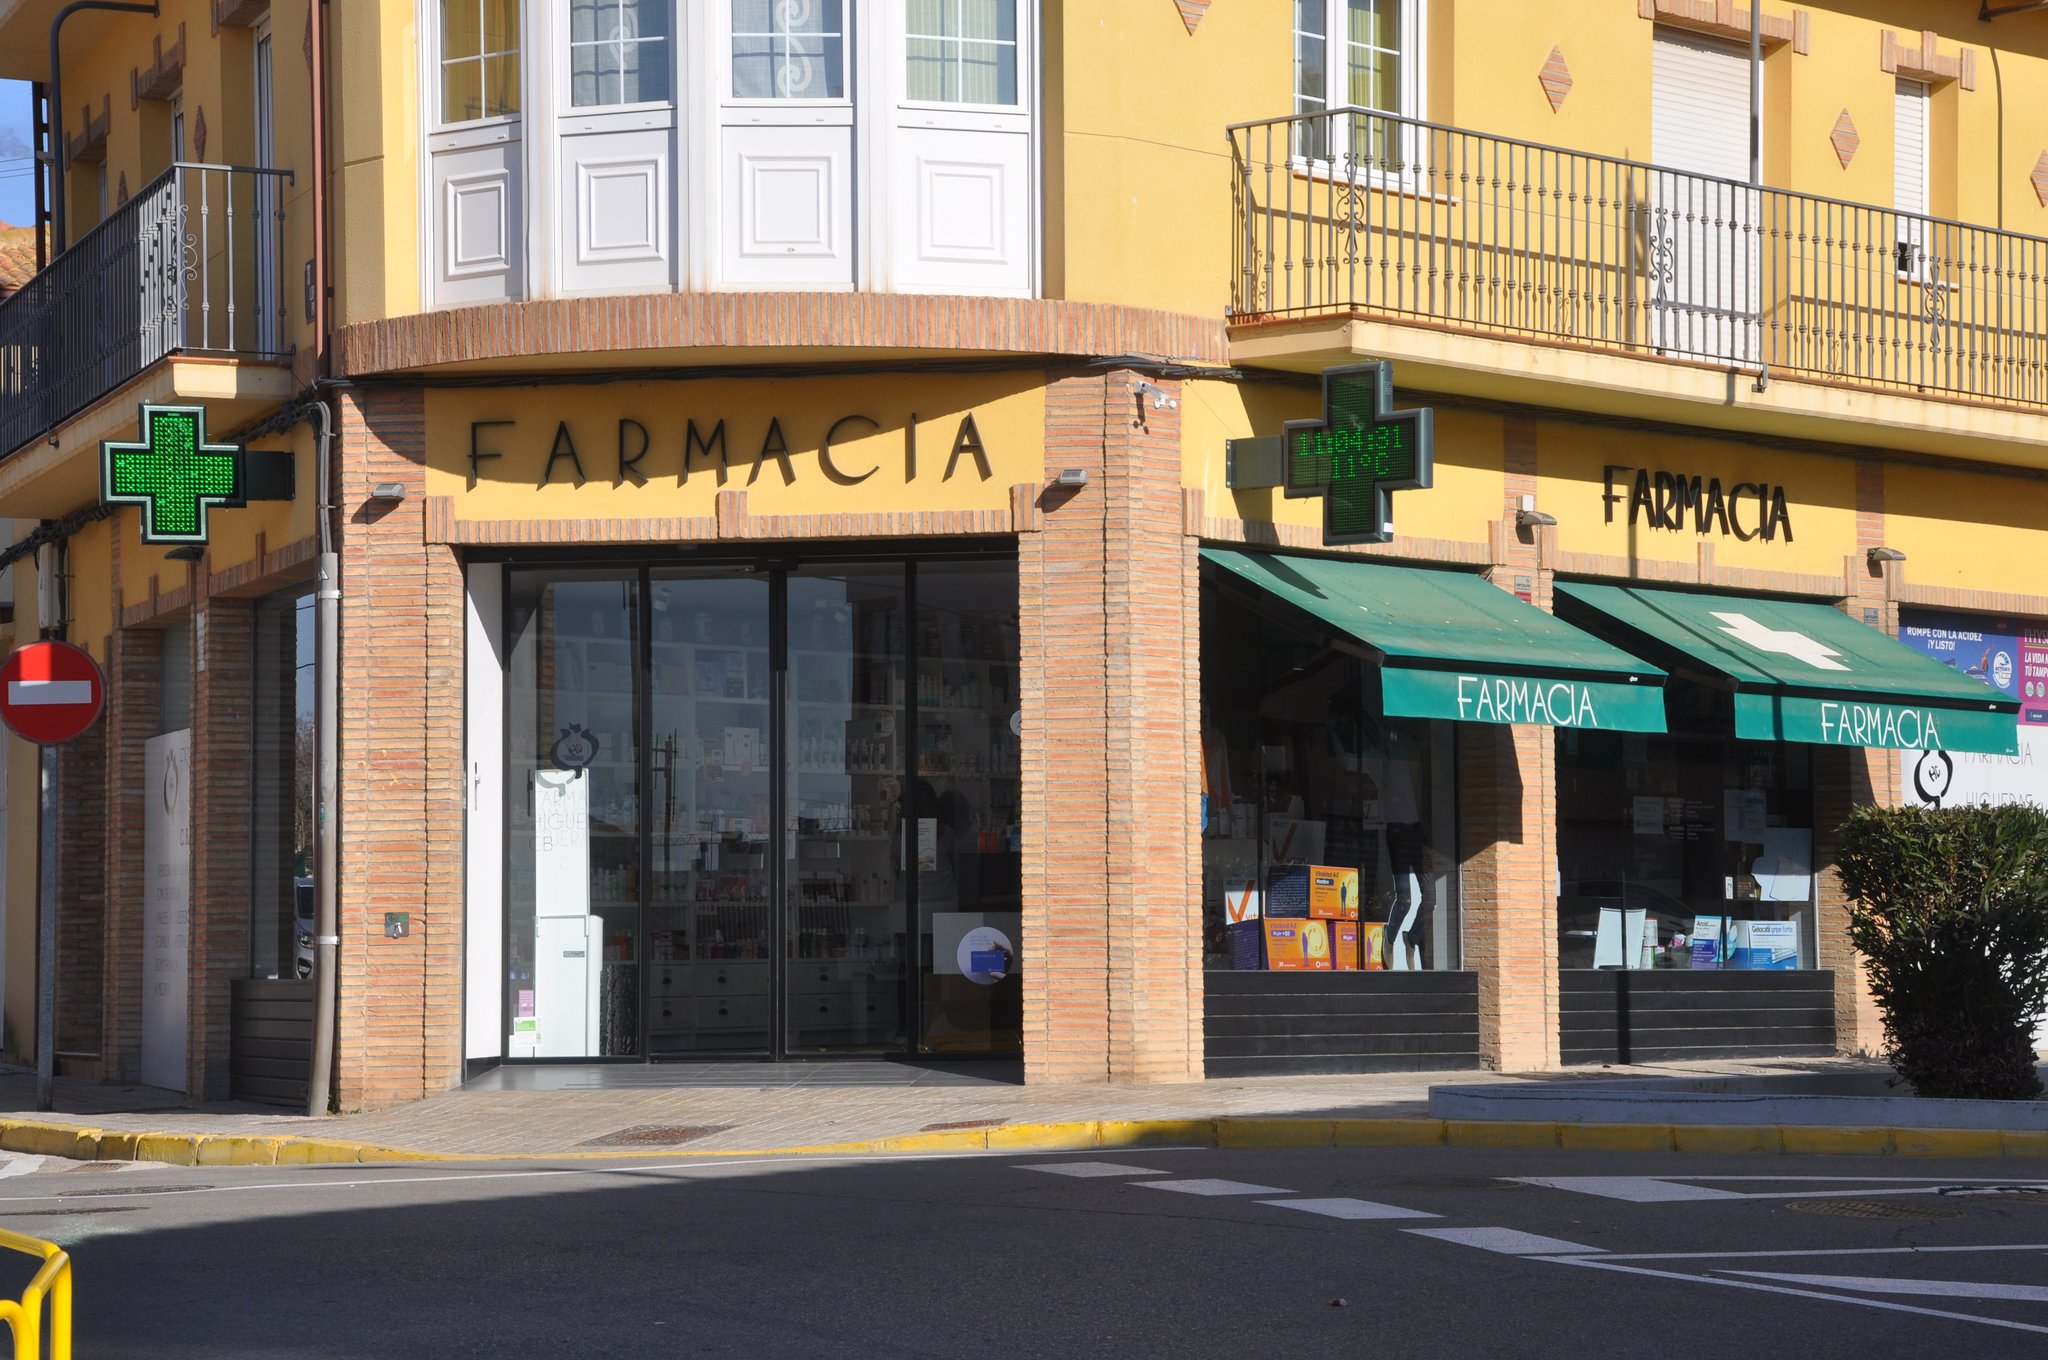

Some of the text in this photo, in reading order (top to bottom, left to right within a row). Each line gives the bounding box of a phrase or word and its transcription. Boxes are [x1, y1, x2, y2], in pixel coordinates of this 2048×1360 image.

[466, 412, 992, 493] FARMACIA
[1602, 464, 1794, 545] FARMACIA
[1907, 627, 1983, 642] ROMPE CON LA ACIDEZ
[2025, 652, 2032, 663] LA
[2032, 652, 2045, 664] VIDA
[2025, 665, 2032, 677] TÚ
[1457, 676, 1598, 727] FARMACIA
[1821, 702, 1942, 749] FARMACIA
